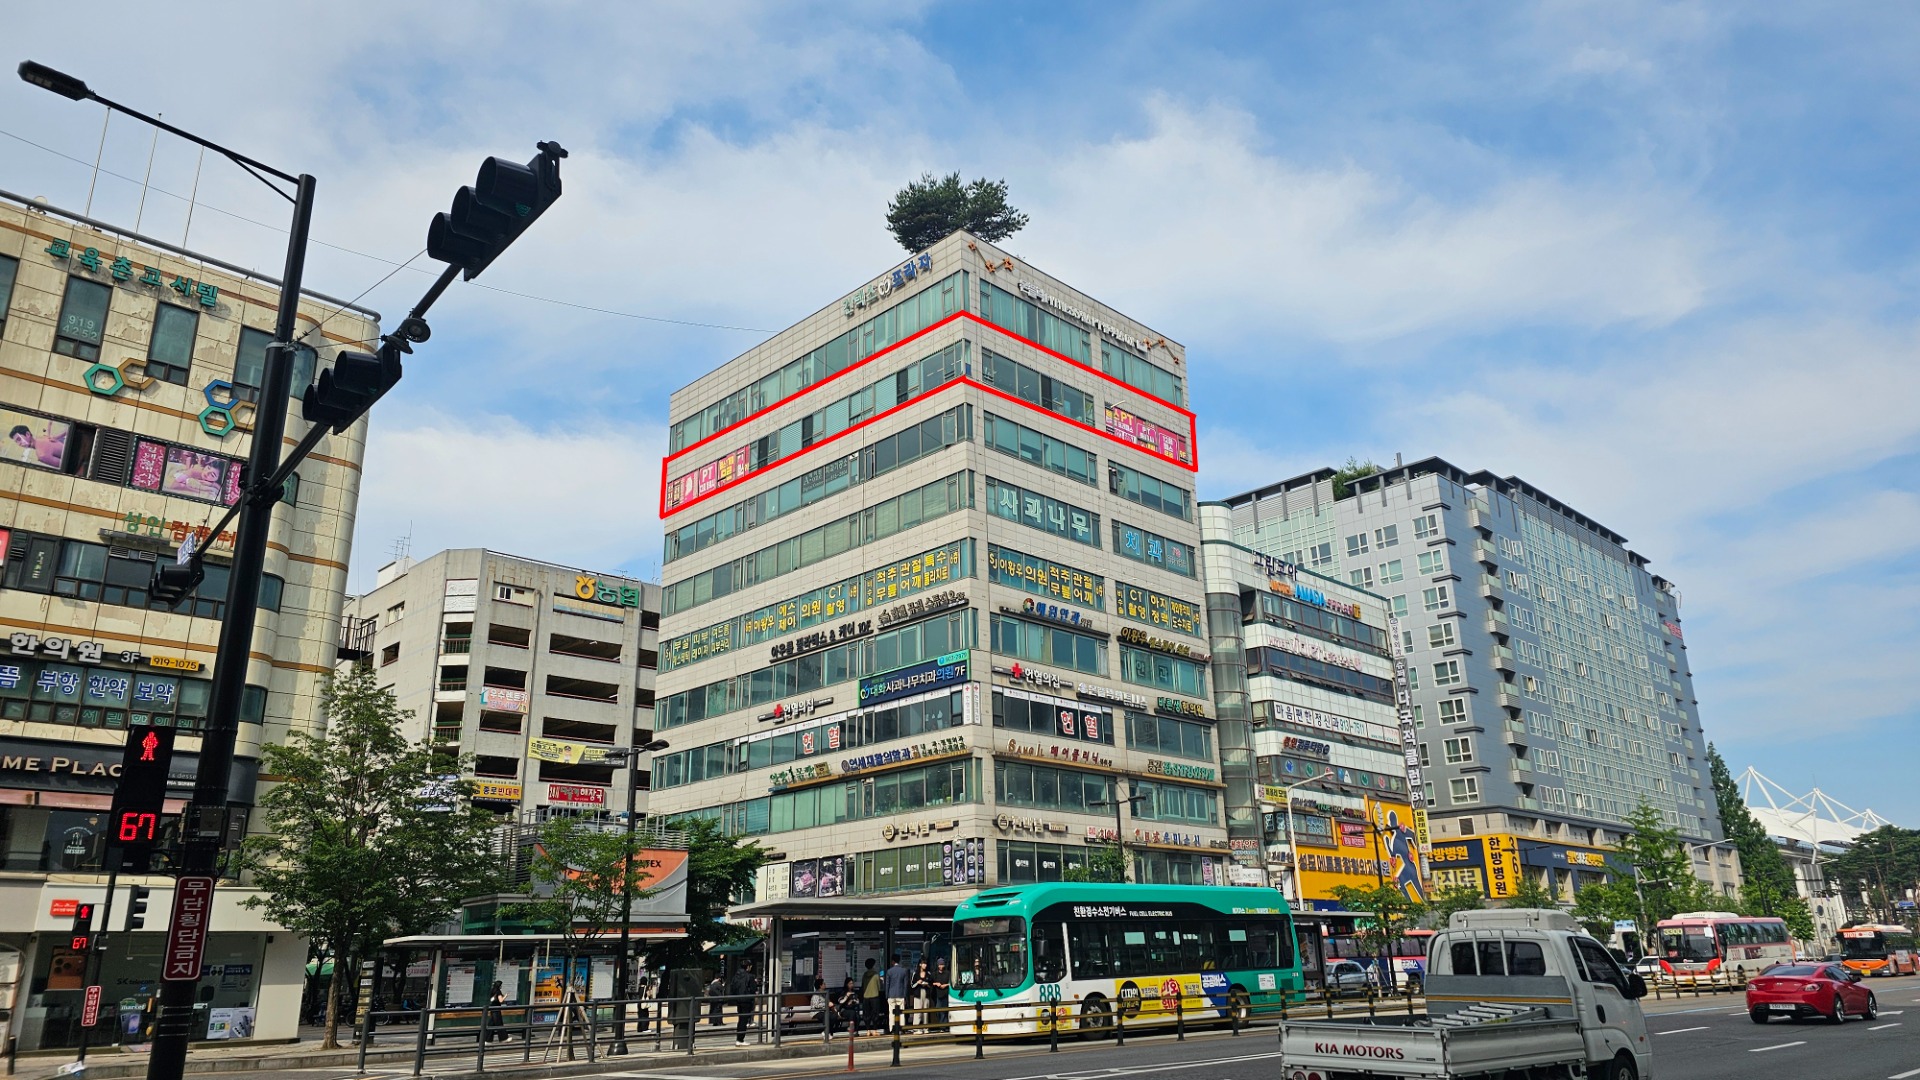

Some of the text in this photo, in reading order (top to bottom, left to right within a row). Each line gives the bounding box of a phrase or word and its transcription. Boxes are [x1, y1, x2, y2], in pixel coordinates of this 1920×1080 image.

[44, 237, 220, 307] 교육촌고시텔
[892, 252, 932, 288] 프라자
[68, 314, 94, 330] 919
[62, 323, 98, 341] 4252
[702, 466, 713, 480] PT
[1000, 487, 1163, 562] 사과나무 치과
[877, 567, 897, 583] 척추
[901, 558, 921, 577] 관절
[924, 550, 948, 567] 특수
[989, 554, 1093, 588] SJ 이황우 의원 척추 관절
[828, 584, 843, 599] CT
[877, 566, 948, 600] 무릎 어깨 물리치료
[597, 580, 640, 607] 농협
[1050, 582, 1072, 600] 무릎
[1072, 590, 1093, 606] 어깨
[1129, 588, 1142, 603] CT
[1150, 594, 1167, 610] 하지
[778, 602, 796, 616] 에스
[801, 600, 821, 617] 의원
[826, 598, 846, 616] 촬영
[1128, 603, 1147, 619] 촬영
[778, 616, 796, 631] 제이
[1151, 610, 1169, 626] 정맥
[1172, 617, 1192, 633] 도수치료
[1121, 626, 1148, 643] 이황우
[10, 632, 198, 670] 한의원 3F 919-1075
[870, 665, 966, 697] 대화사과나무치과의원 7F
[1024, 666, 1061, 688] 헌혈의집
[37, 669, 80, 695] 부항
[88, 675, 128, 700] 한약
[134, 681, 175, 705] 보약
[490, 688, 528, 703] 우수렌트카
[783, 697, 815, 718] 헌혈의집
[1275, 702, 1339, 728] 마음편한정신과
[1060, 711, 1099, 739] 헌혈
[802, 726, 841, 755] 헌혈
[0, 756, 123, 778] ME PLAC
[849, 747, 911, 772] 연세재활의학과
[177, 772, 197, 780] desse
[580, 788, 603, 802] 해장국
[1411, 791, 1424, 801] B1
[119, 812, 156, 841] 67
[1487, 836, 1508, 896] 한방병원
[1073, 905, 1127, 918] 친환경수소전기버스
[170, 881, 207, 976] 무단횡단금지
[72, 937, 88, 949] 67
[1202, 974, 1227, 988] 공공버스
[1315, 1042, 1404, 1060] KIA MOTORS
